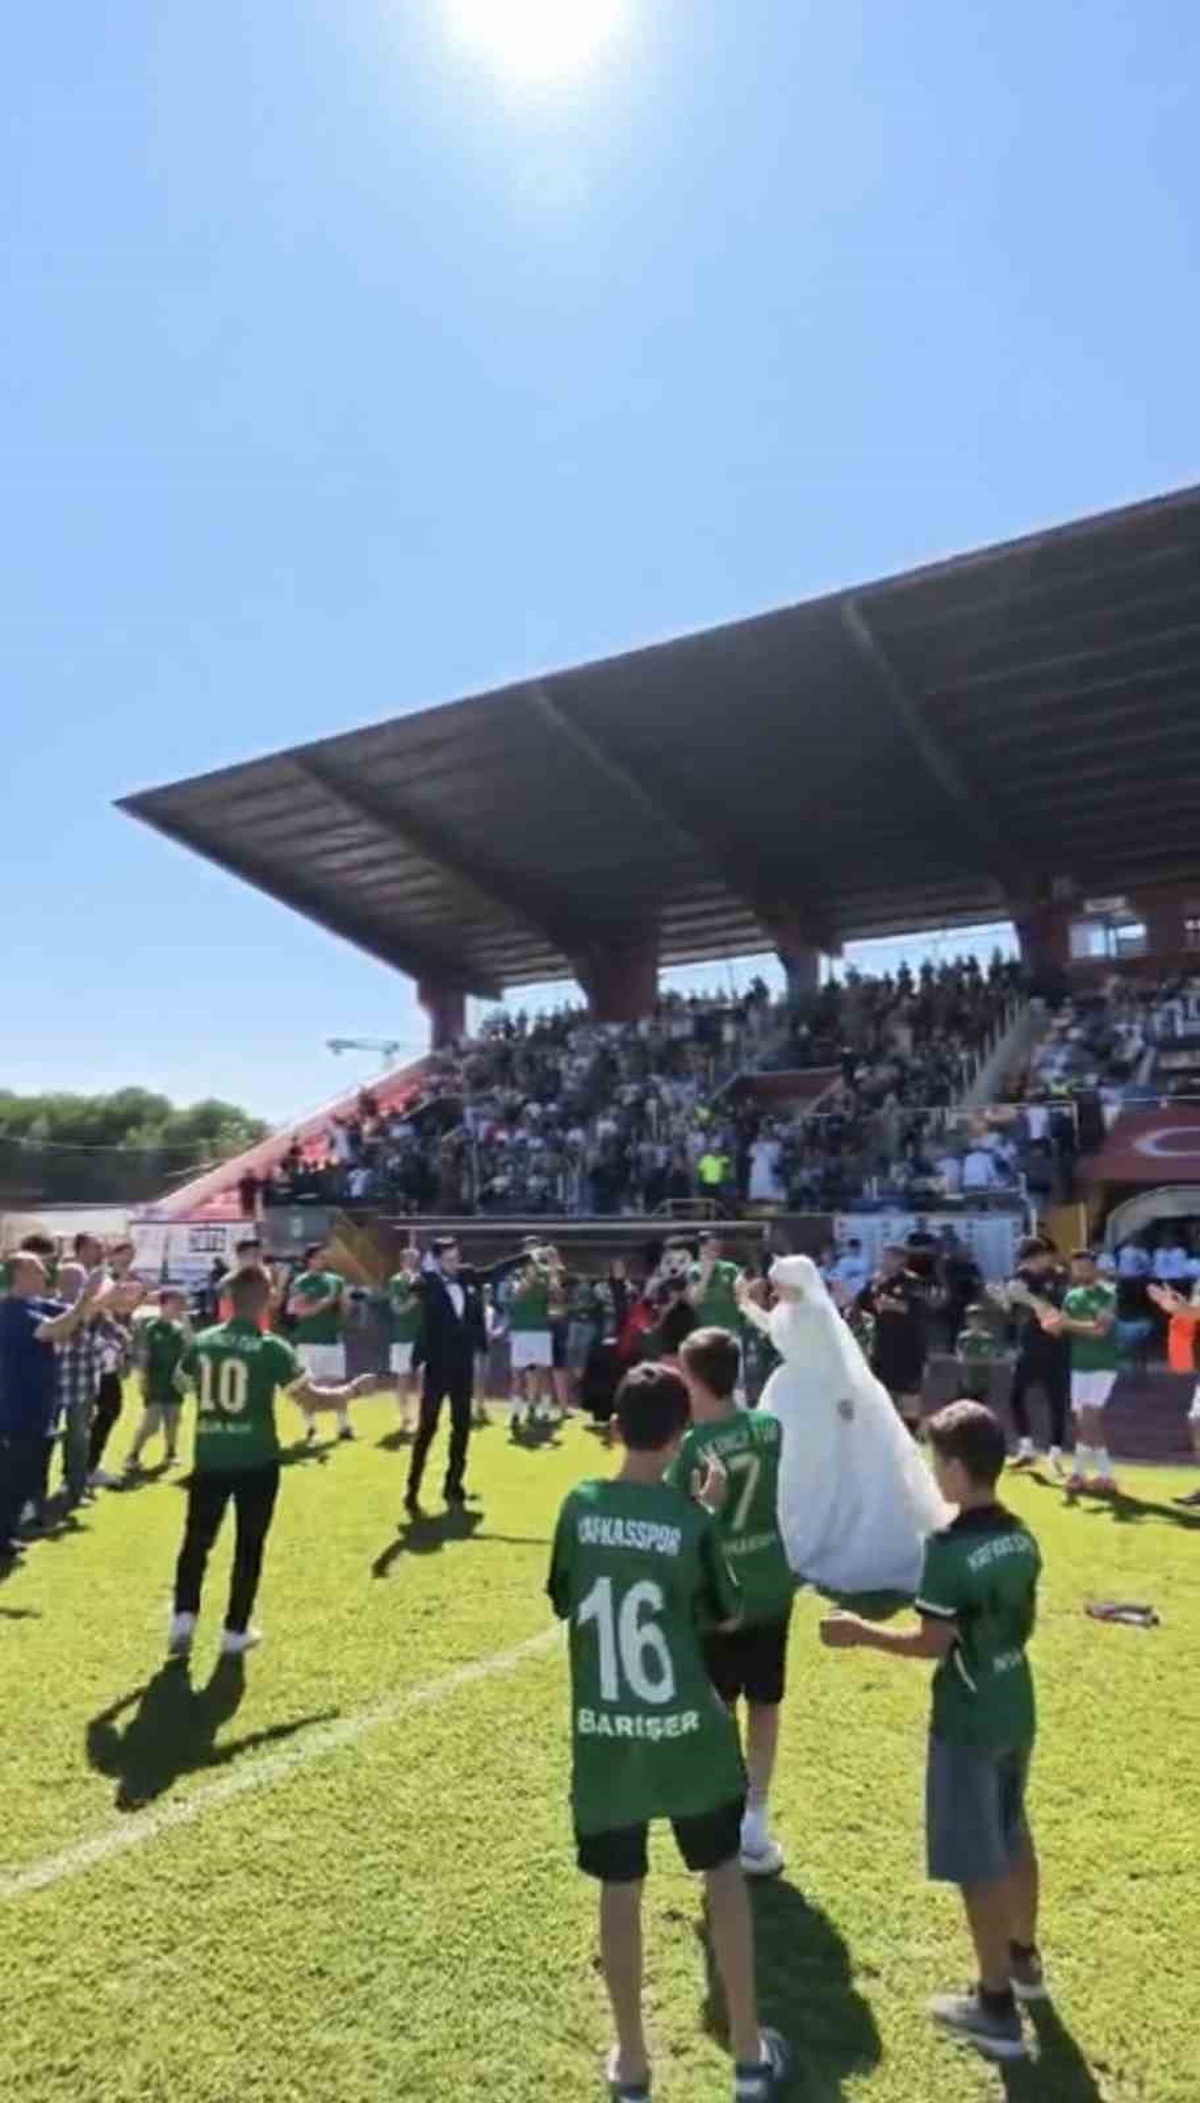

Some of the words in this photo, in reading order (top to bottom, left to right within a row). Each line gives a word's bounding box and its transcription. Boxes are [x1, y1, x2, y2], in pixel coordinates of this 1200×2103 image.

[199, 1353, 248, 1413] 10
[727, 1452, 760, 1530] 7
[577, 1576, 677, 1704] 16
